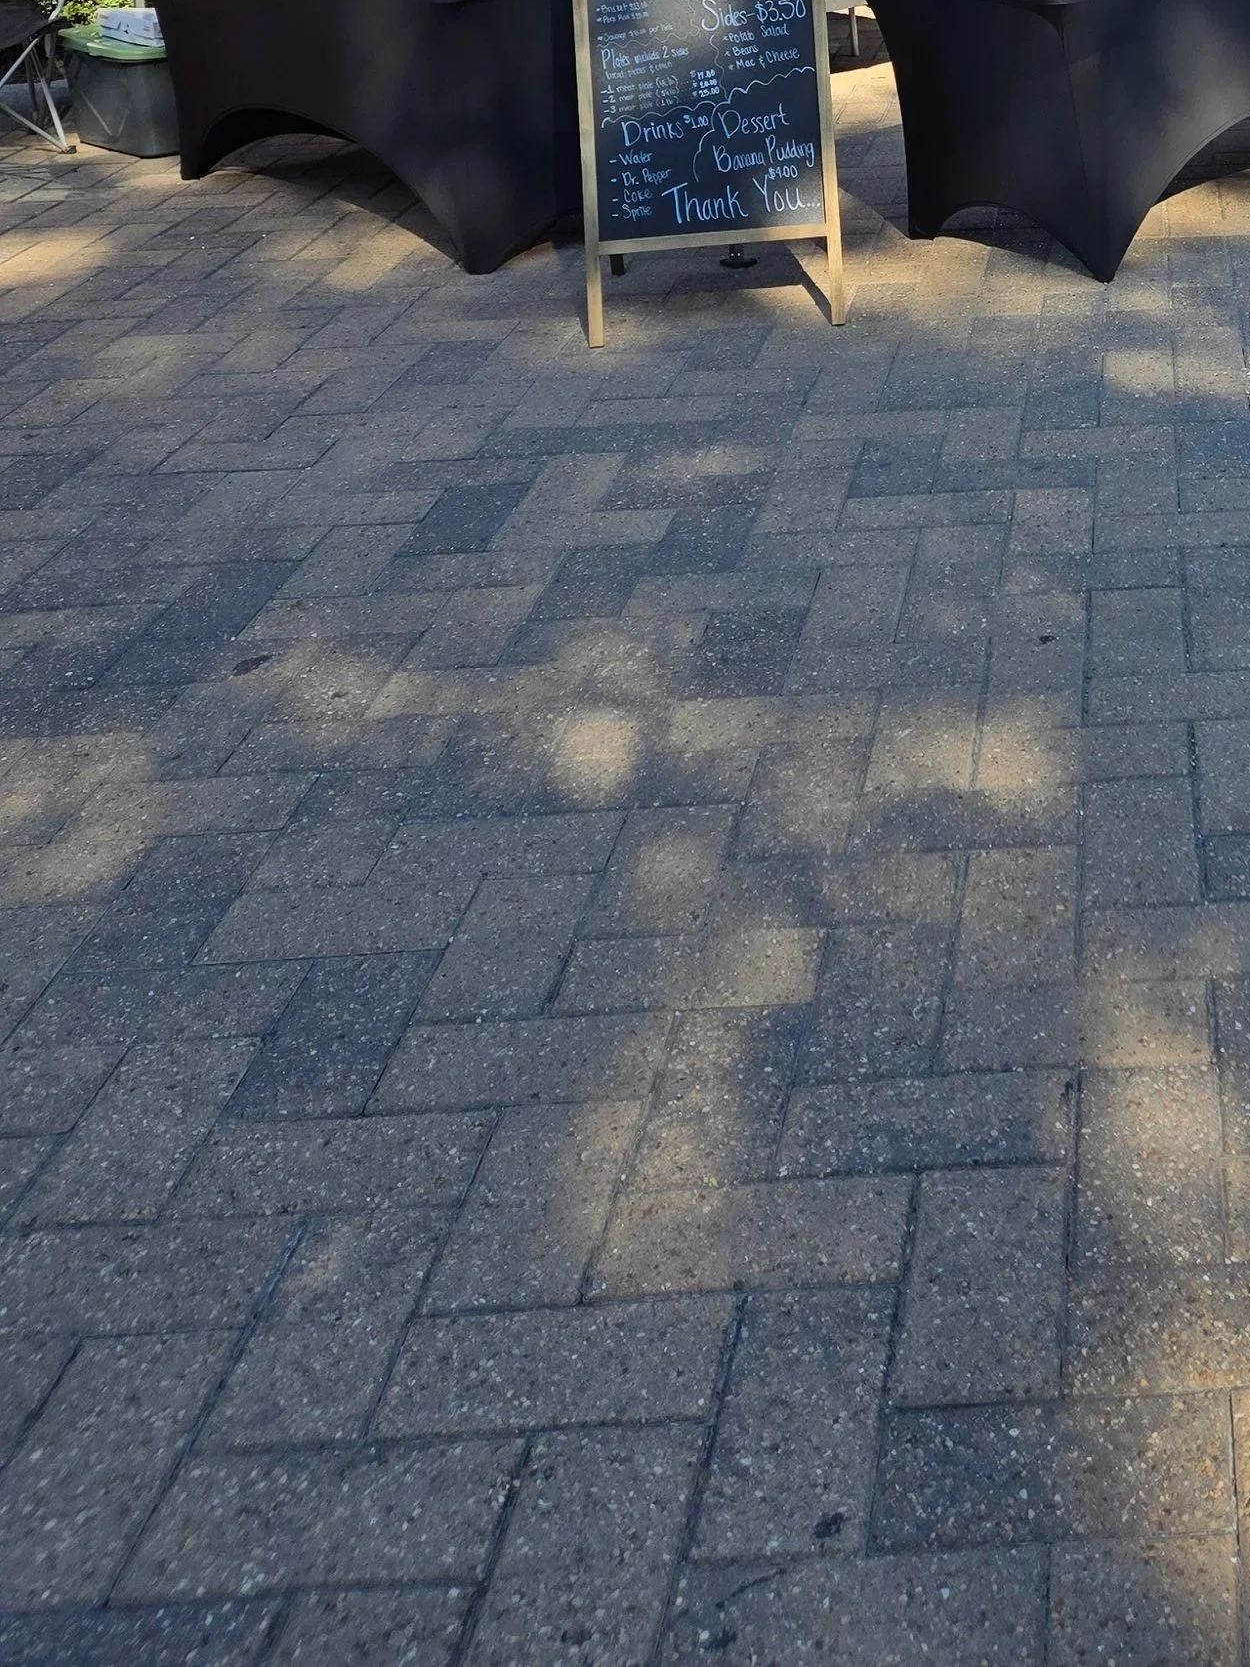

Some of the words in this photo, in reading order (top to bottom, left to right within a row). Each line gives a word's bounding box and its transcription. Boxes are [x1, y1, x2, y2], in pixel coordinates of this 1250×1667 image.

[729, 31, 755, 43] Potato
[760, 23, 790, 38] Salad
[662, 45, 669, 59] 2
[732, 44, 759, 56] Beans
[735, 58, 755, 70] Mac
[765, 48, 800, 63] Cheese
[621, 120, 684, 147] Drinks
[683, 114, 709, 129] $1.00
[717, 103, 790, 139] Dessert
[619, 149, 652, 166] Water
[712, 145, 766, 172] Banana
[765, 134, 815, 168] Pudding
[622, 172, 639, 186] Dr.
[642, 168, 672, 185] Pepper
[623, 189, 653, 203] Coke
[661, 182, 748, 224] Thank
[622, 203, 652, 221] Sprite
